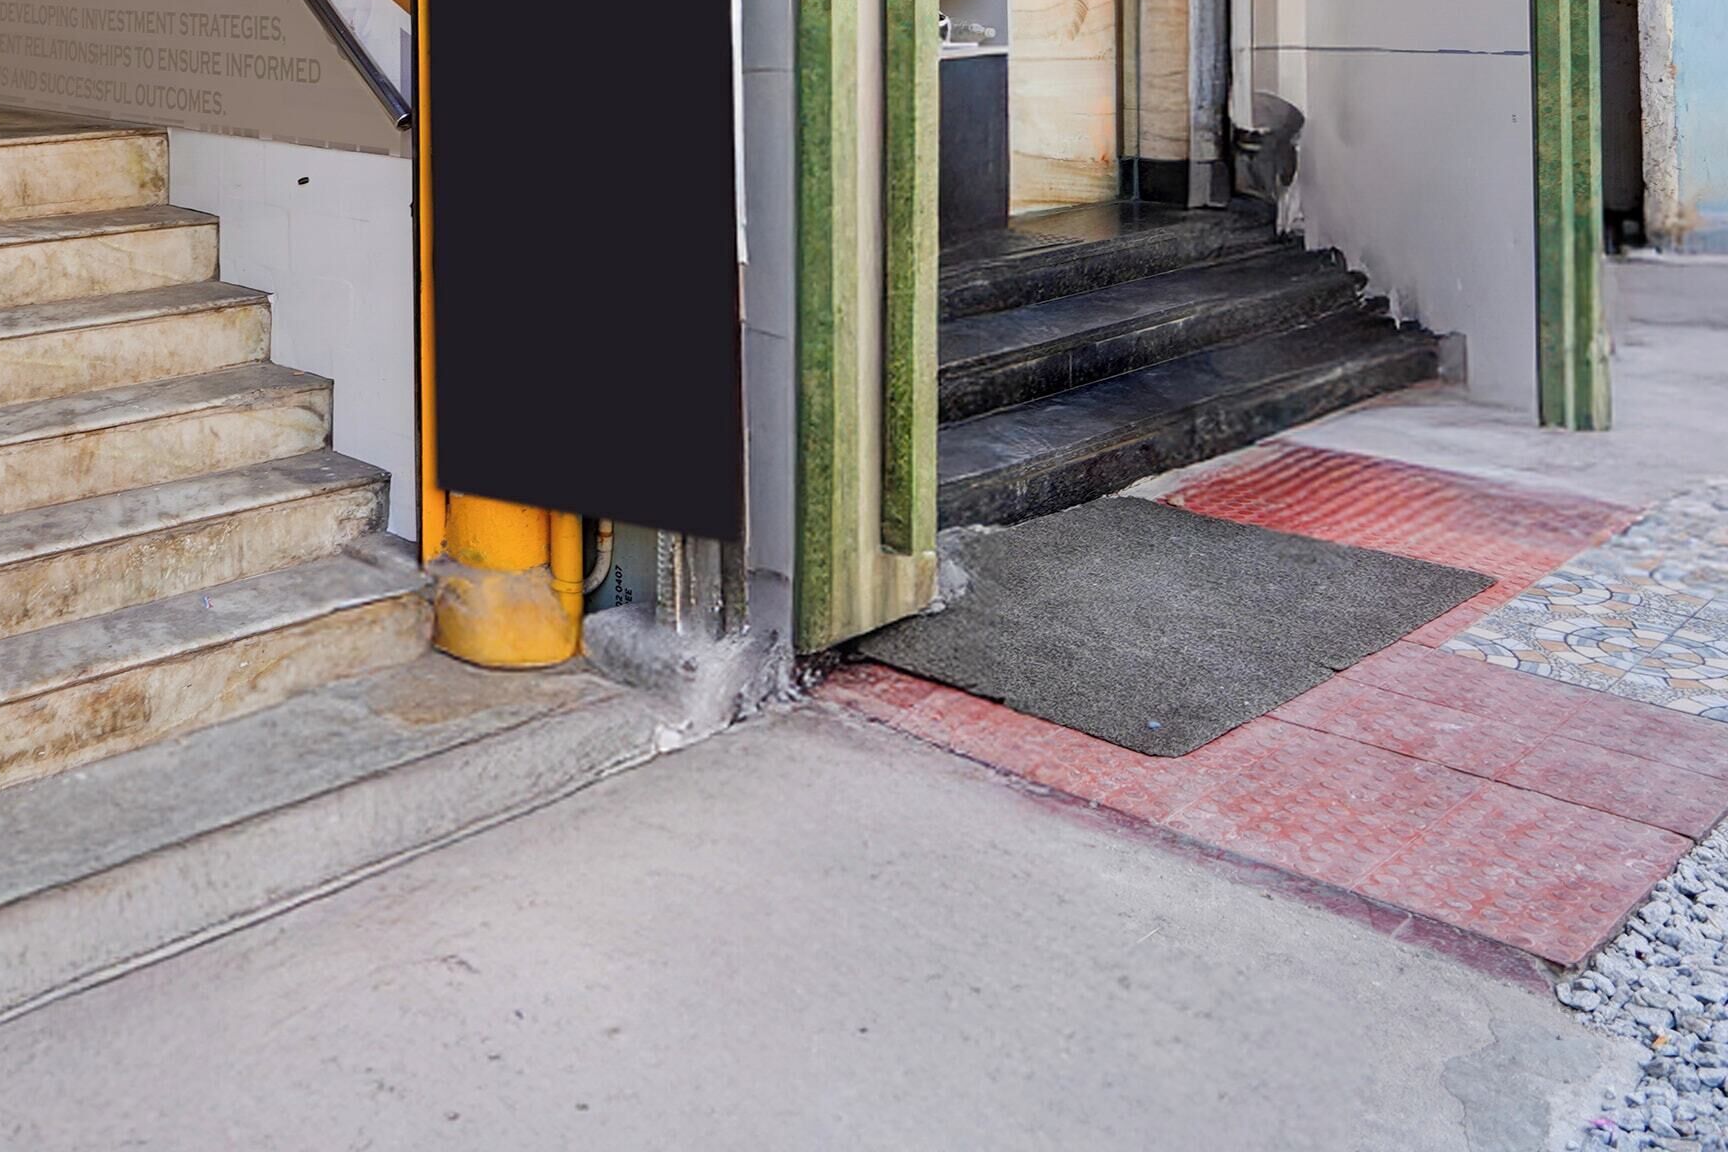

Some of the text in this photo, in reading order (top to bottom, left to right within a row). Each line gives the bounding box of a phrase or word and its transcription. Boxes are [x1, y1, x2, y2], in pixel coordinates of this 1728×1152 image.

[0, 1, 78, 28] DEVELOPING
[11, 66, 37, 90] AND
[135, 47, 154, 69] TO
[158, 48, 222, 76] ENSURE
[225, 54, 321, 84] INFORMED
